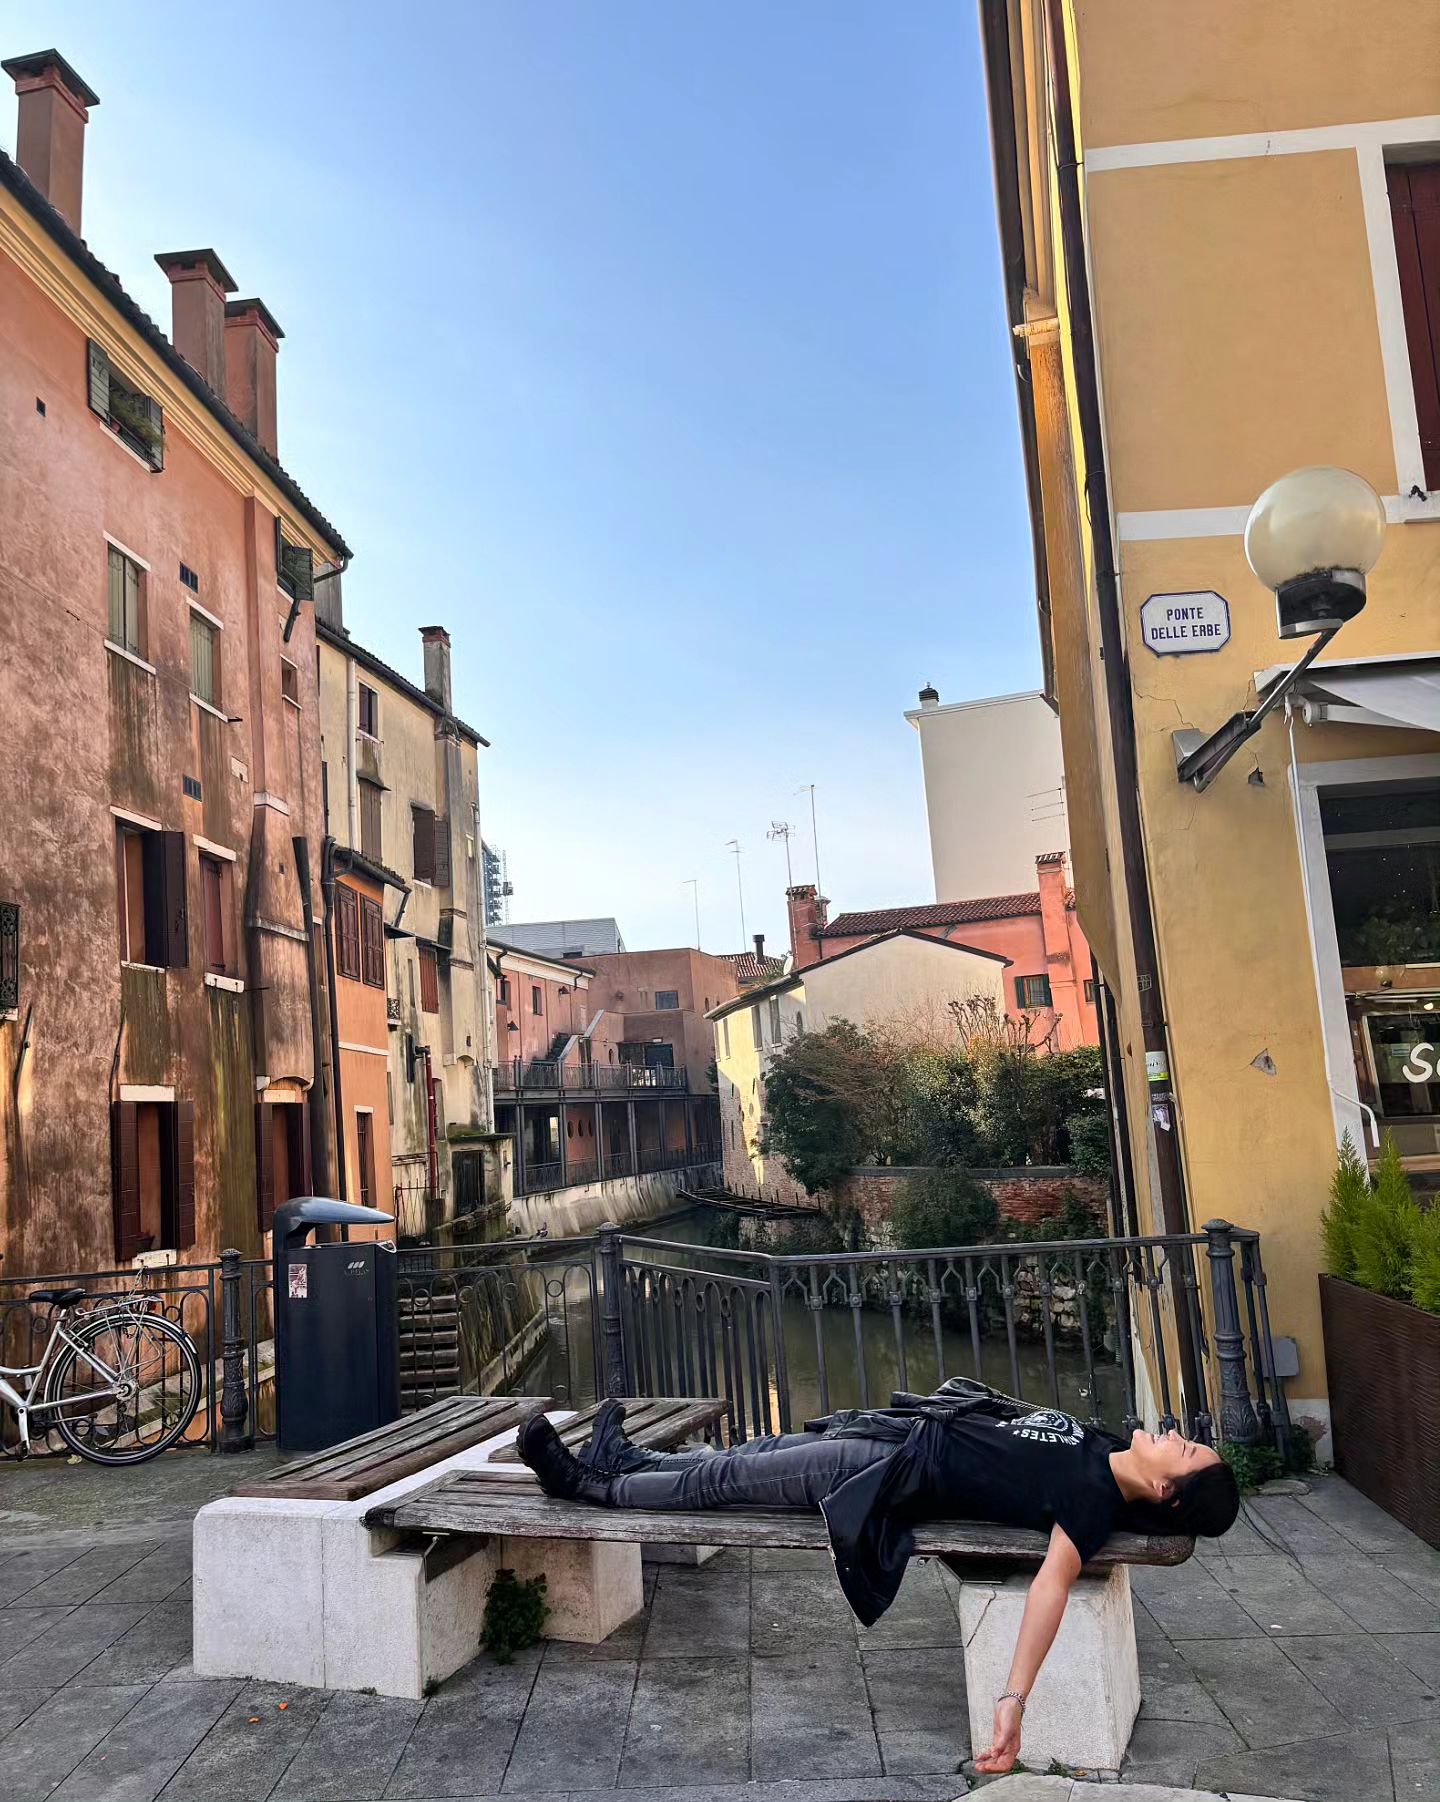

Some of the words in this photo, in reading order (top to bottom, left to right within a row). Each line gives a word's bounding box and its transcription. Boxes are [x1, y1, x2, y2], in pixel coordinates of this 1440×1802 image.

[1166, 607, 1205, 621] PONTE
[1151, 625, 1188, 640] DELLE
[1191, 623, 1222, 638] ERBE
